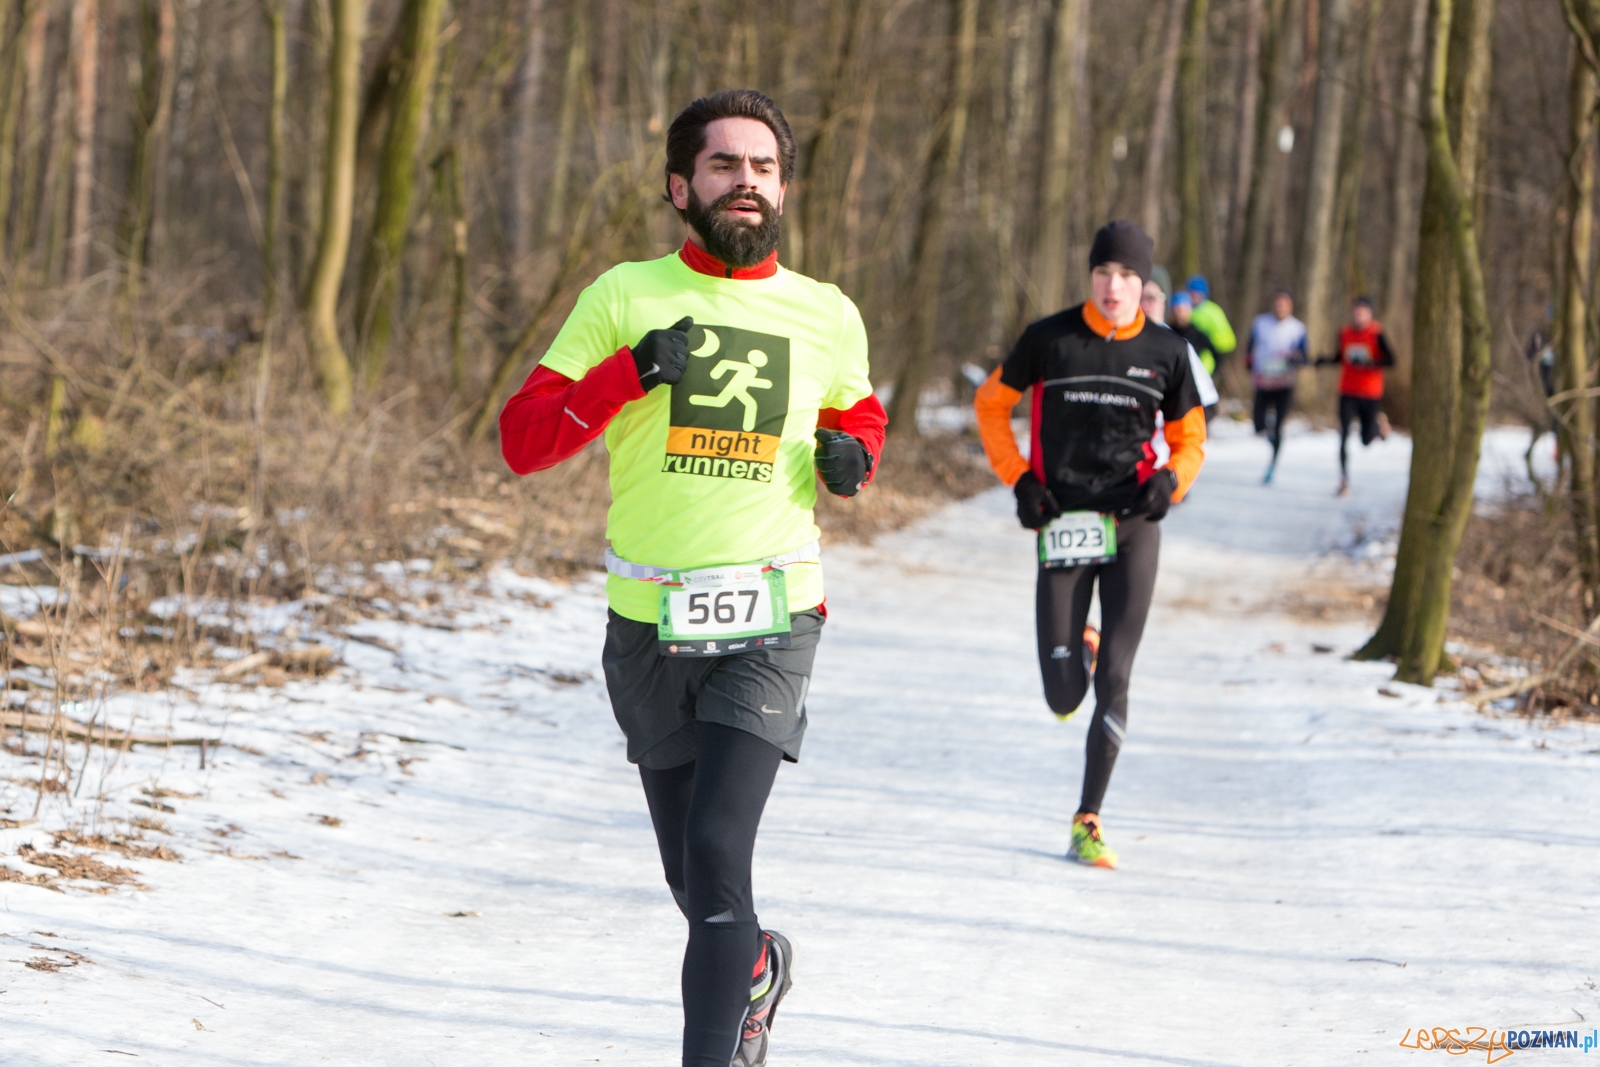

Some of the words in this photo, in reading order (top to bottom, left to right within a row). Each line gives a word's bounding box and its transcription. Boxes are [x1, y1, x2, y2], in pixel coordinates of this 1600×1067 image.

[691, 430, 761, 457] night
[661, 455, 772, 483] runners
[1049, 527, 1103, 549] 1023
[688, 590, 759, 625] 567
